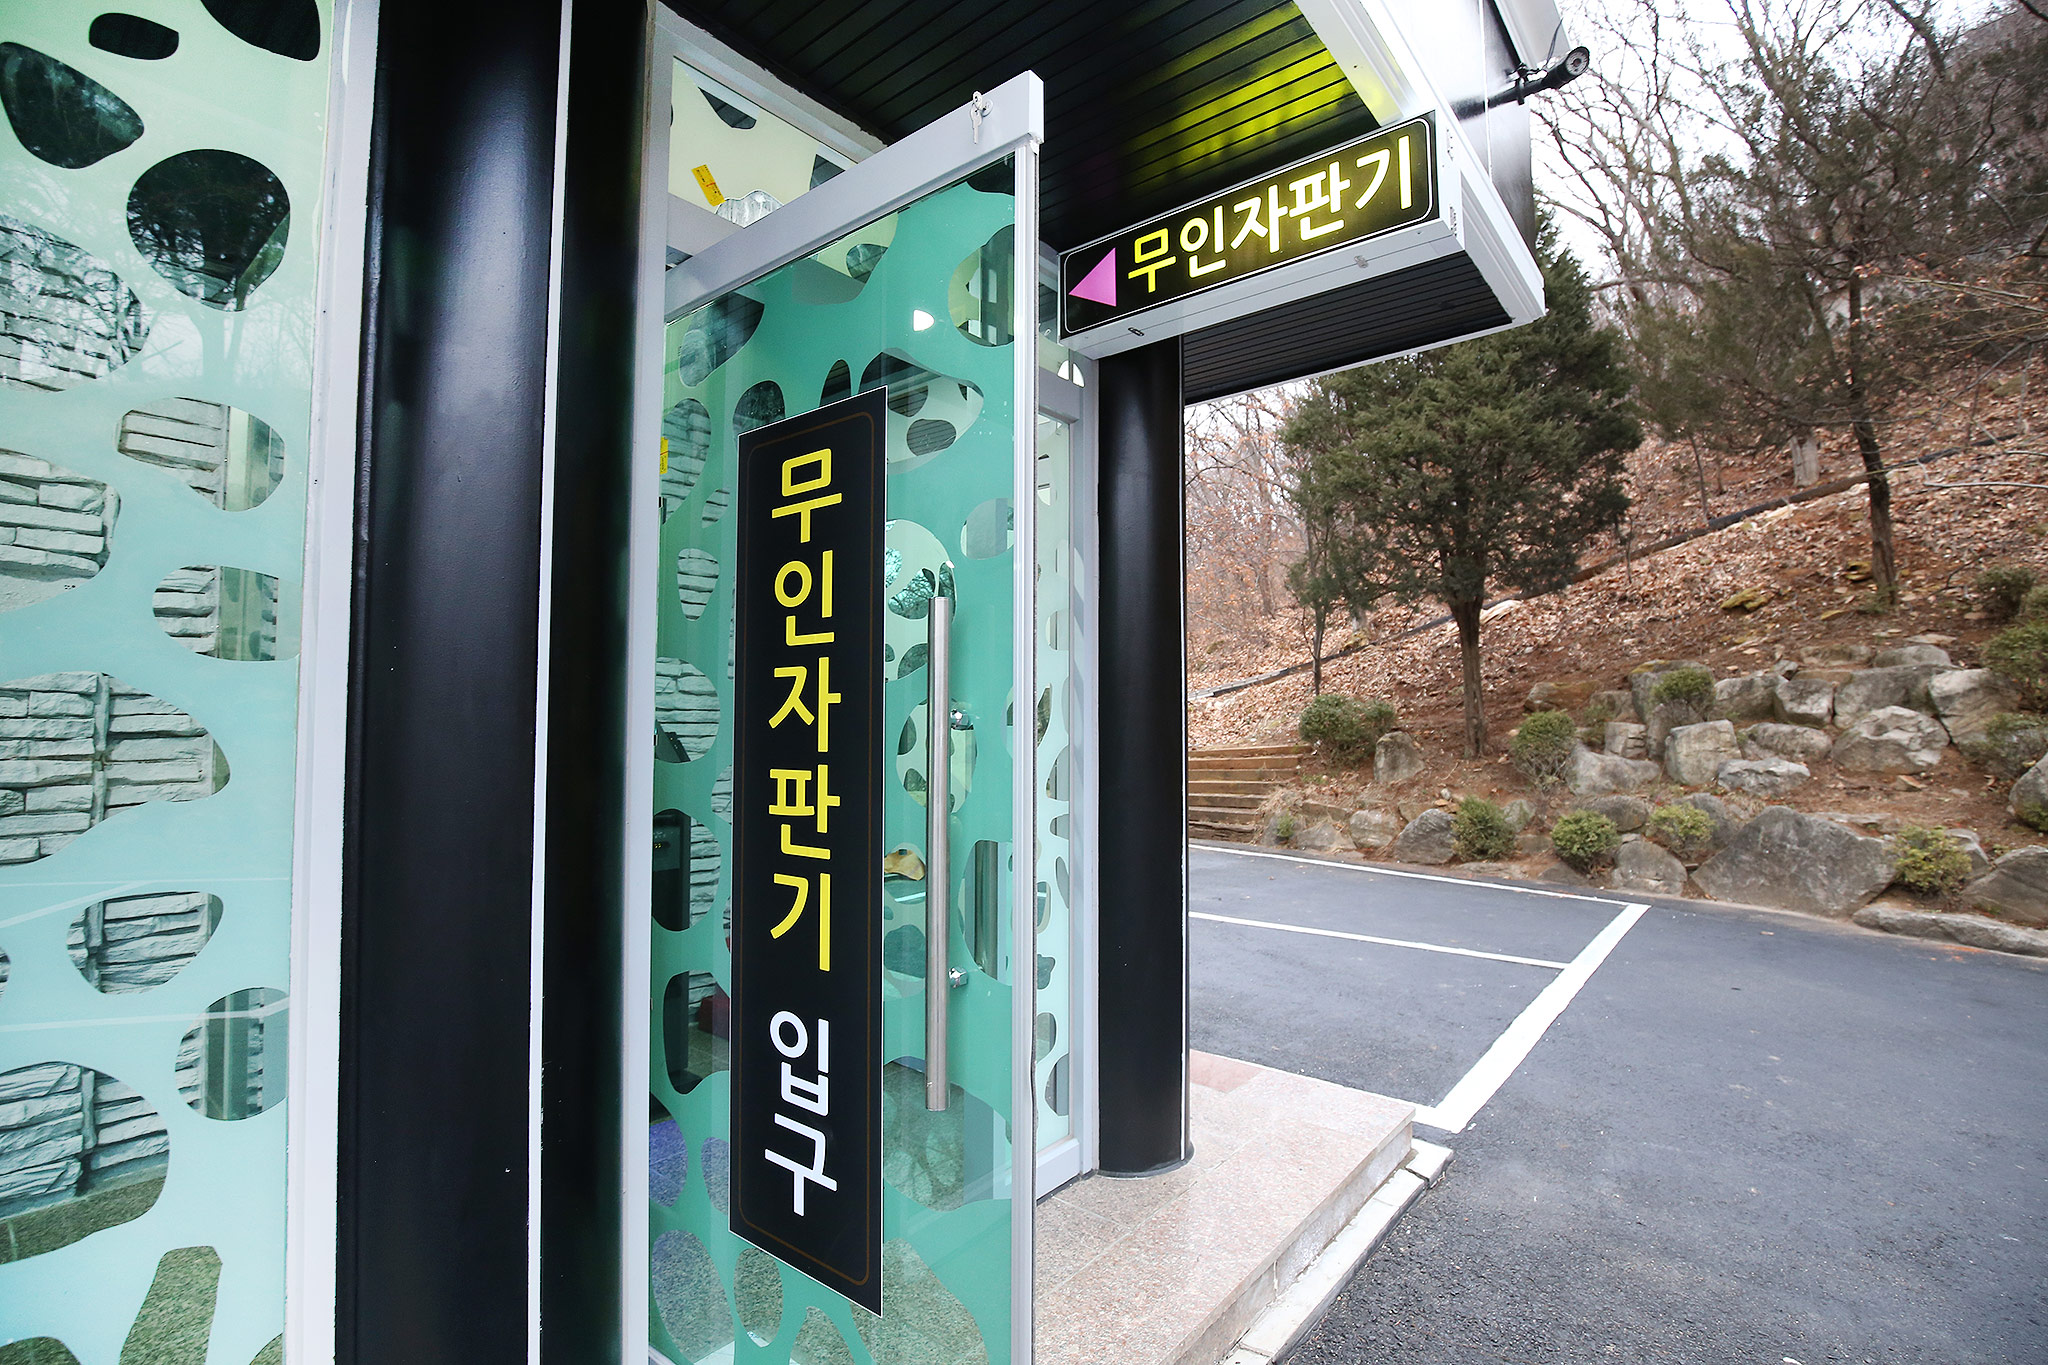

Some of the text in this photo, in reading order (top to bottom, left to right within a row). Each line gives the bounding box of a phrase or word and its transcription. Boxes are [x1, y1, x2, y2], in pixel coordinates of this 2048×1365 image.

[1128, 136, 1412, 293] 무인자판기
[764, 448, 843, 1217] 무인자판기 입구
